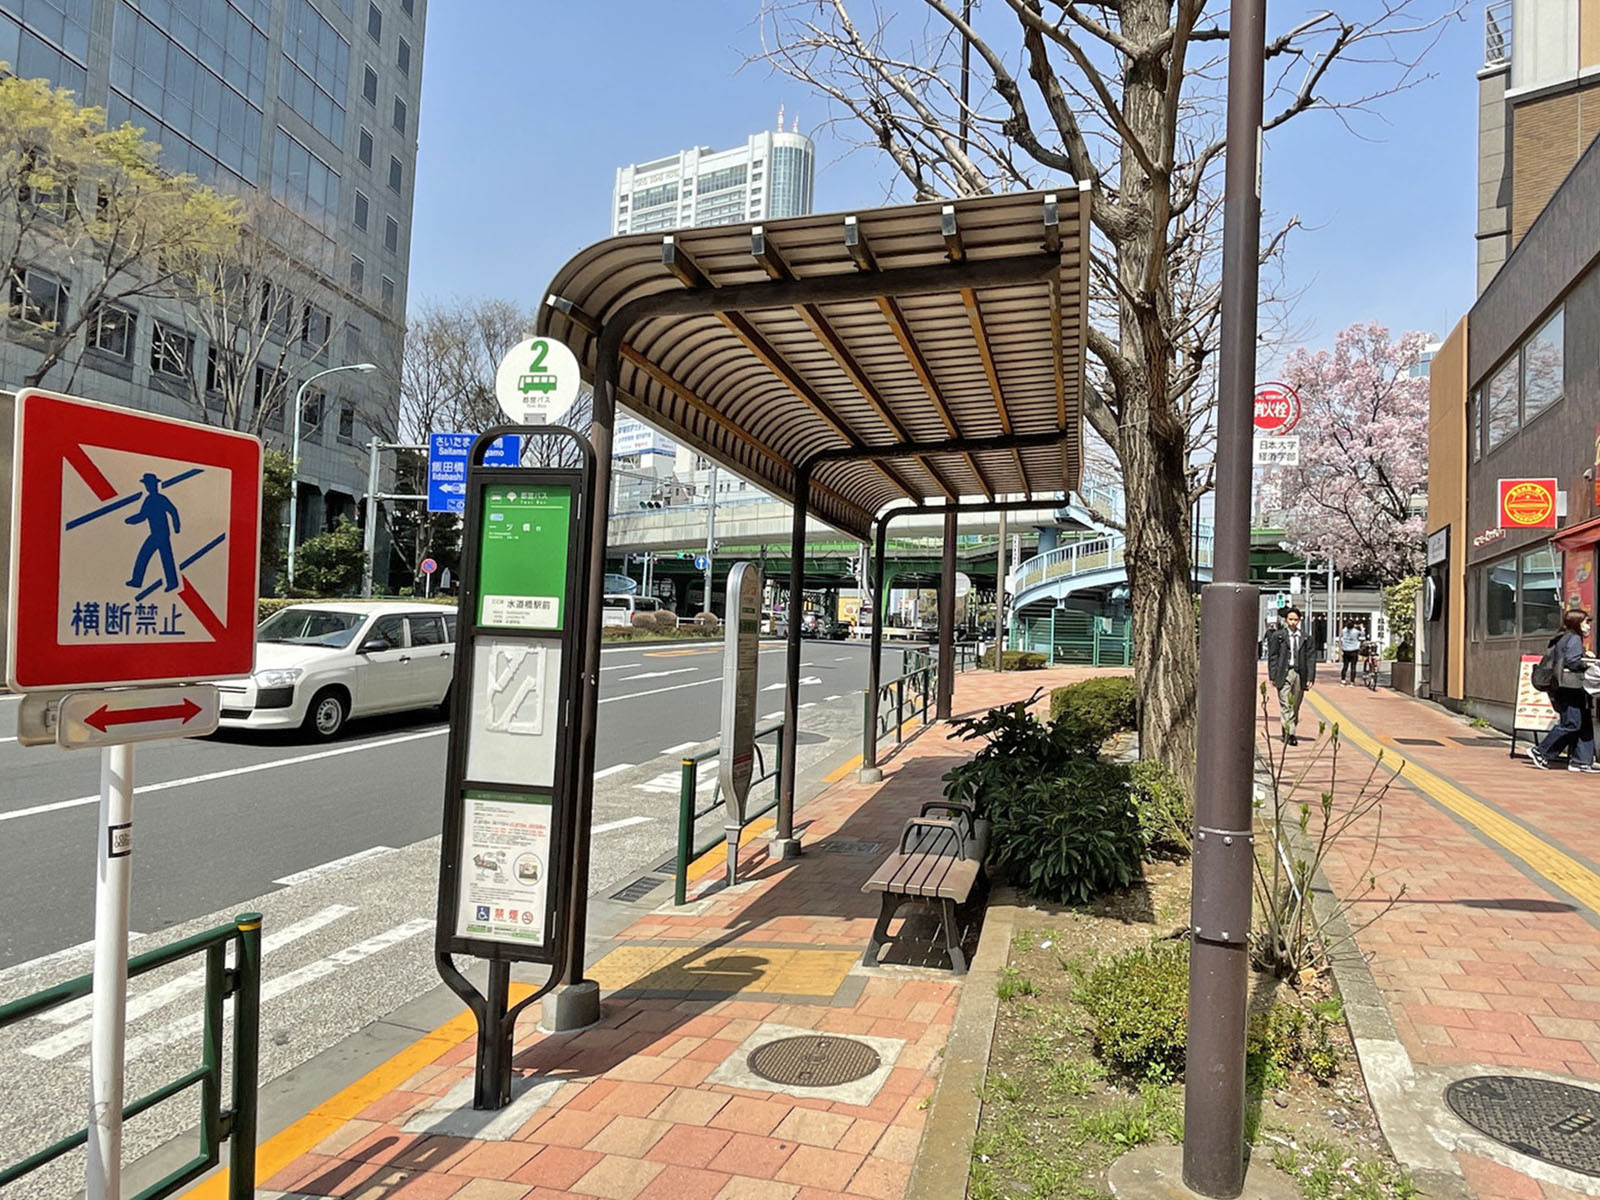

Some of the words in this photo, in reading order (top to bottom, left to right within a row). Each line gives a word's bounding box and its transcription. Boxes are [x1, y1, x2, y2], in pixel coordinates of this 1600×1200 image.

[529, 340, 549, 373] 2
[435, 437, 471, 448] さいたま
[1259, 440, 1297, 450] 日本大学
[71, 602, 185, 636] 横断禁止
